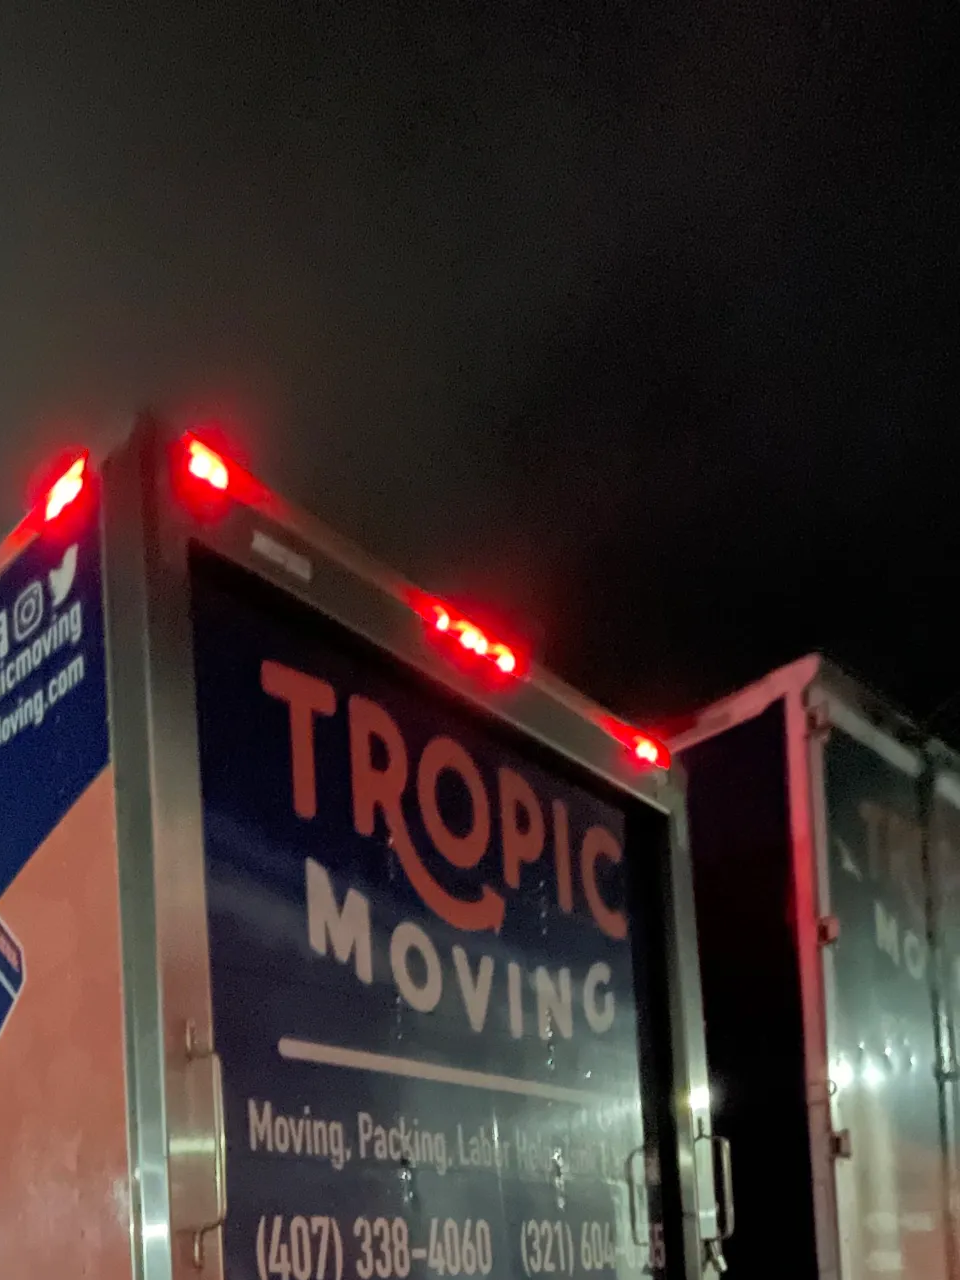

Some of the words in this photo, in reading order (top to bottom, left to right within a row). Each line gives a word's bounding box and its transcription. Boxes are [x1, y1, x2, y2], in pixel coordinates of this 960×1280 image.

[260, 658, 628, 940] TROPIC
[305, 856, 616, 1041] MOVING
[247, 1097, 352, 1171] Moving,
[357, 1111, 452, 1176] Packing,
[353, 1215, 493, 1280] 338-4060
[520, 1218, 576, 1278] (321)
[580, 1219, 666, 1272] 604-05
